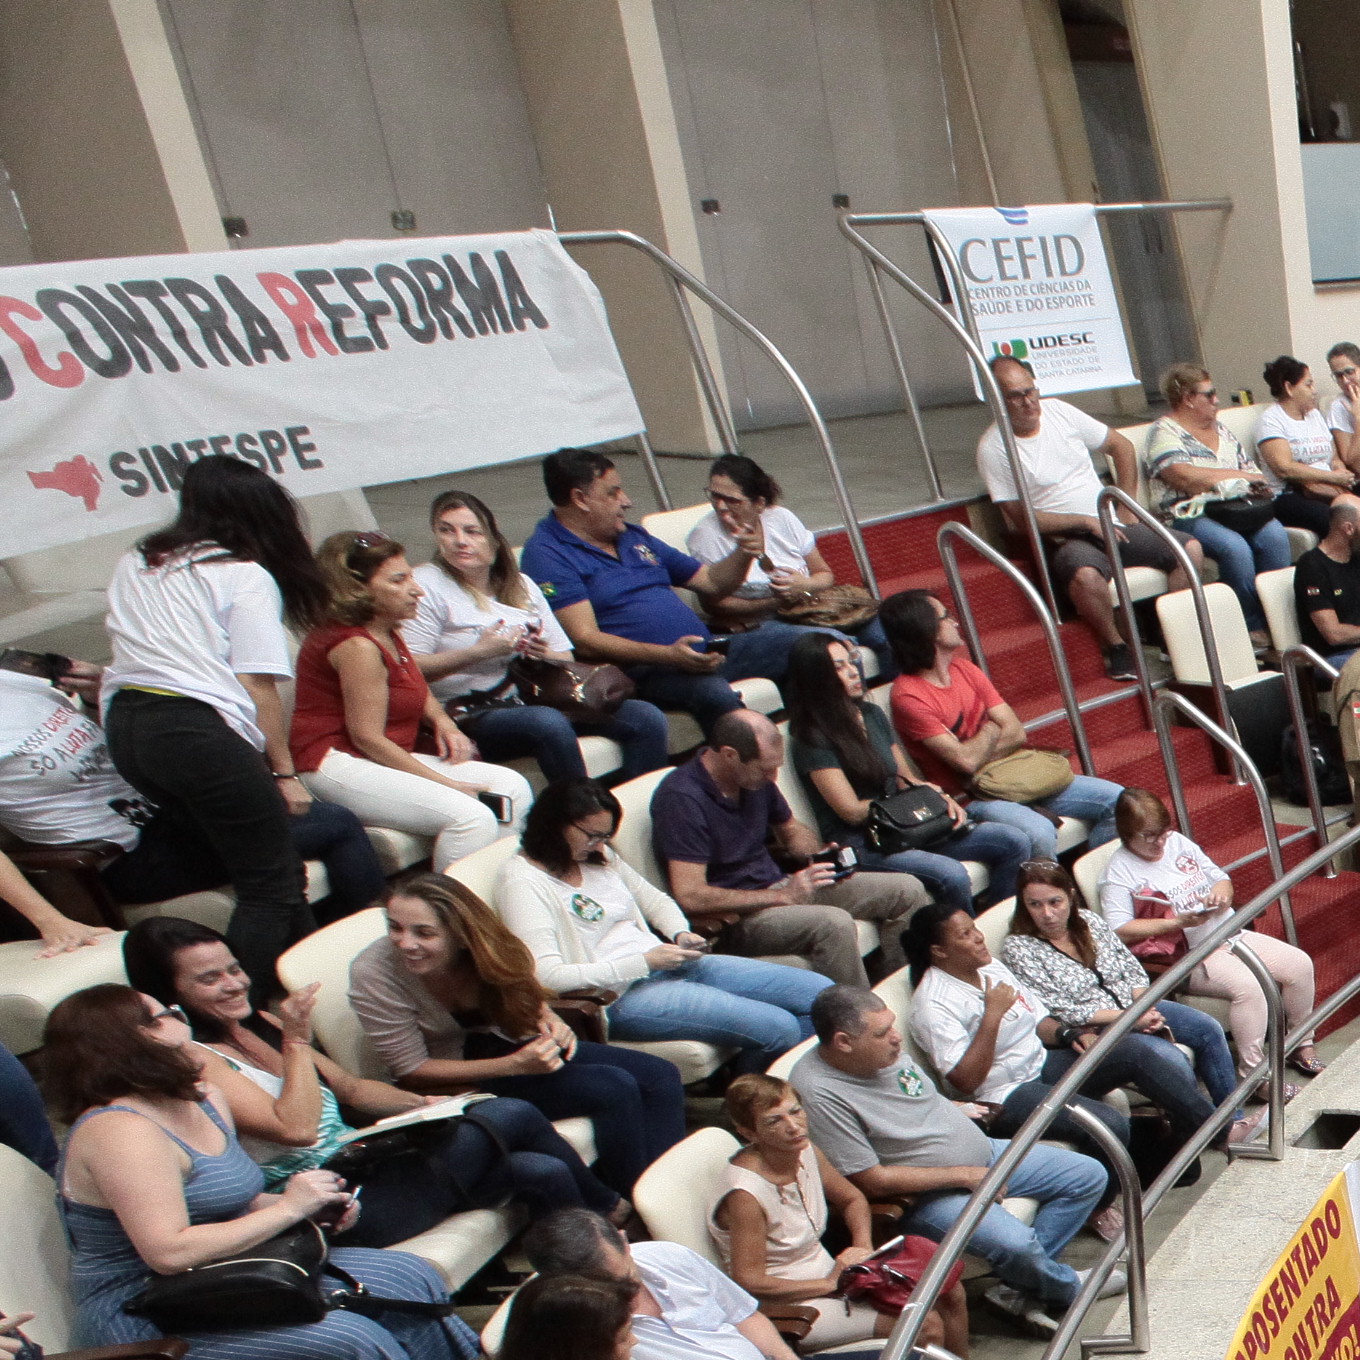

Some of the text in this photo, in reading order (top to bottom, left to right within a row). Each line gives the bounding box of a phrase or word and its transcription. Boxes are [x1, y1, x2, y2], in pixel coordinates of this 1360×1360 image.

[960, 233, 1085, 284] CEFID
[970, 286, 1011, 300] CENTRO
[1014, 285, 1028, 296] DE
[1077, 279, 1092, 291] DA
[1016, 301, 1023, 312] E
[1026, 299, 1044, 311] DO
[1046, 293, 1096, 310] ESPORTE
[0, 275, 291, 389] CONTRA
[256, 250, 548, 358] REFORMA
[1028, 331, 1095, 350] UDESC
